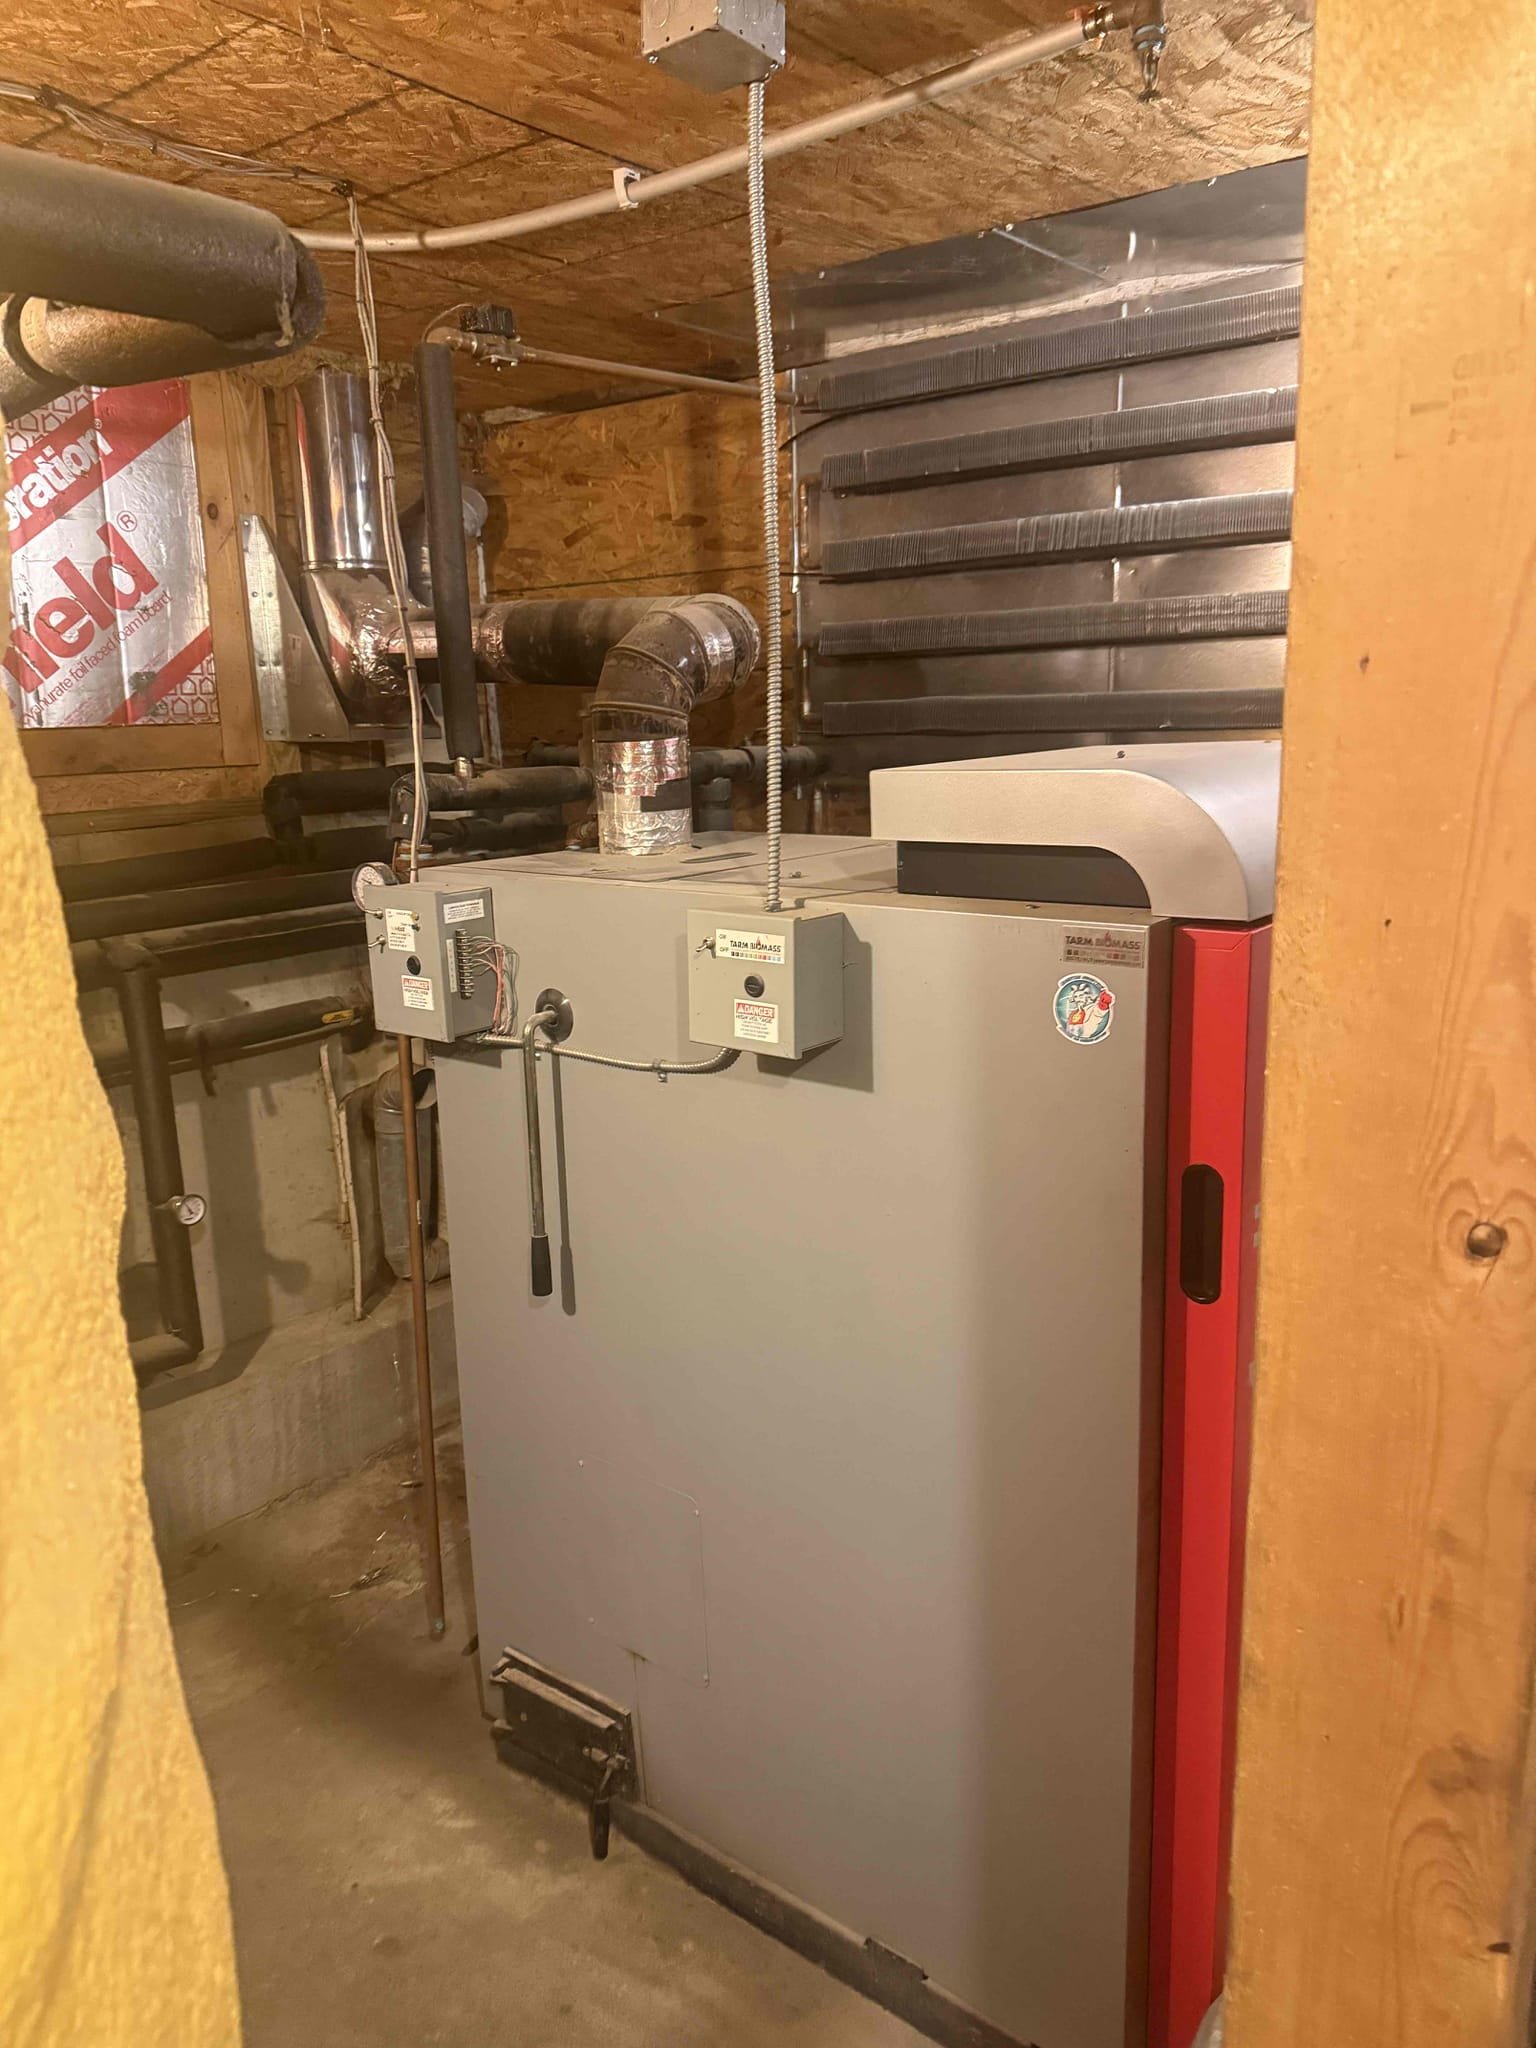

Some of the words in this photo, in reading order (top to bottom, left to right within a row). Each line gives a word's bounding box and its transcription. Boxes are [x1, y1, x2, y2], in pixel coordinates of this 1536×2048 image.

[69, 660, 91, 685] foil
[84, 637, 118, 669] faced
[111, 614, 144, 648] foam
[138, 589, 174, 620] board
[730, 940, 748, 948] TARM
[750, 942, 781, 952] BIOMASS
[1065, 935, 1094, 946] TARM
[1095, 937, 1142, 950] BIOMASS
[744, 1004, 774, 1017] DANGER
